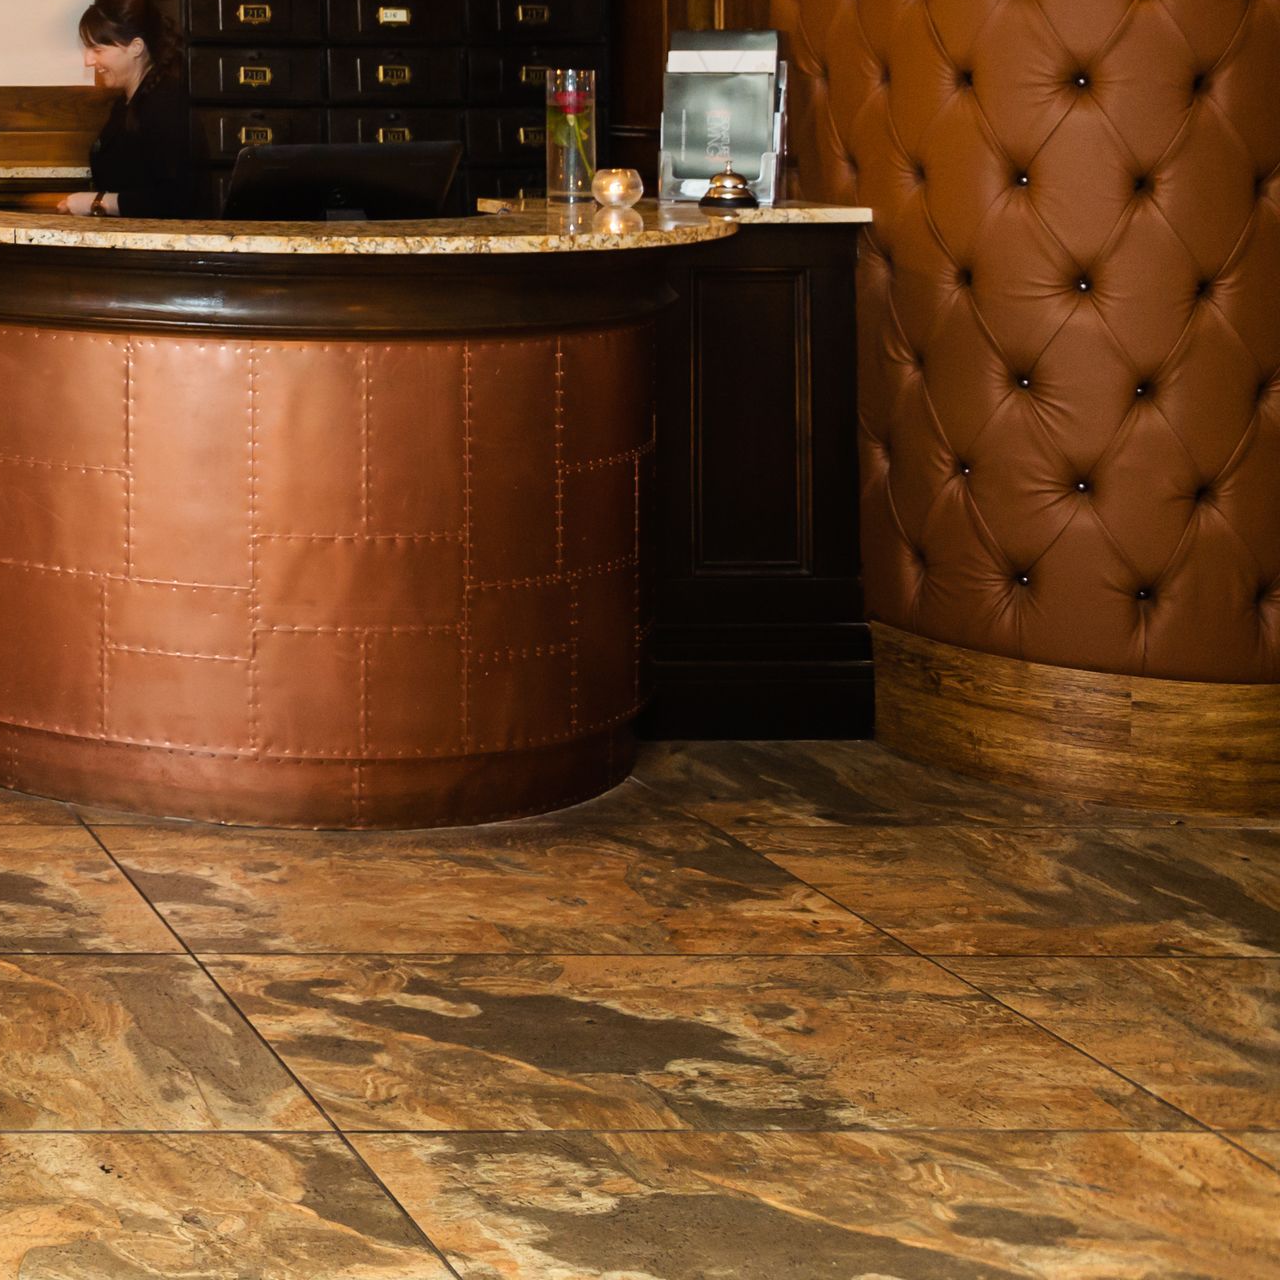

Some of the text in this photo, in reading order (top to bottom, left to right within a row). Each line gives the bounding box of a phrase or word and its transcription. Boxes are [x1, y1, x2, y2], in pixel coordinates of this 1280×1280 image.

[247, 8, 265, 19] 215
[246, 70, 265, 81] 218
[386, 69, 405, 80] 219
